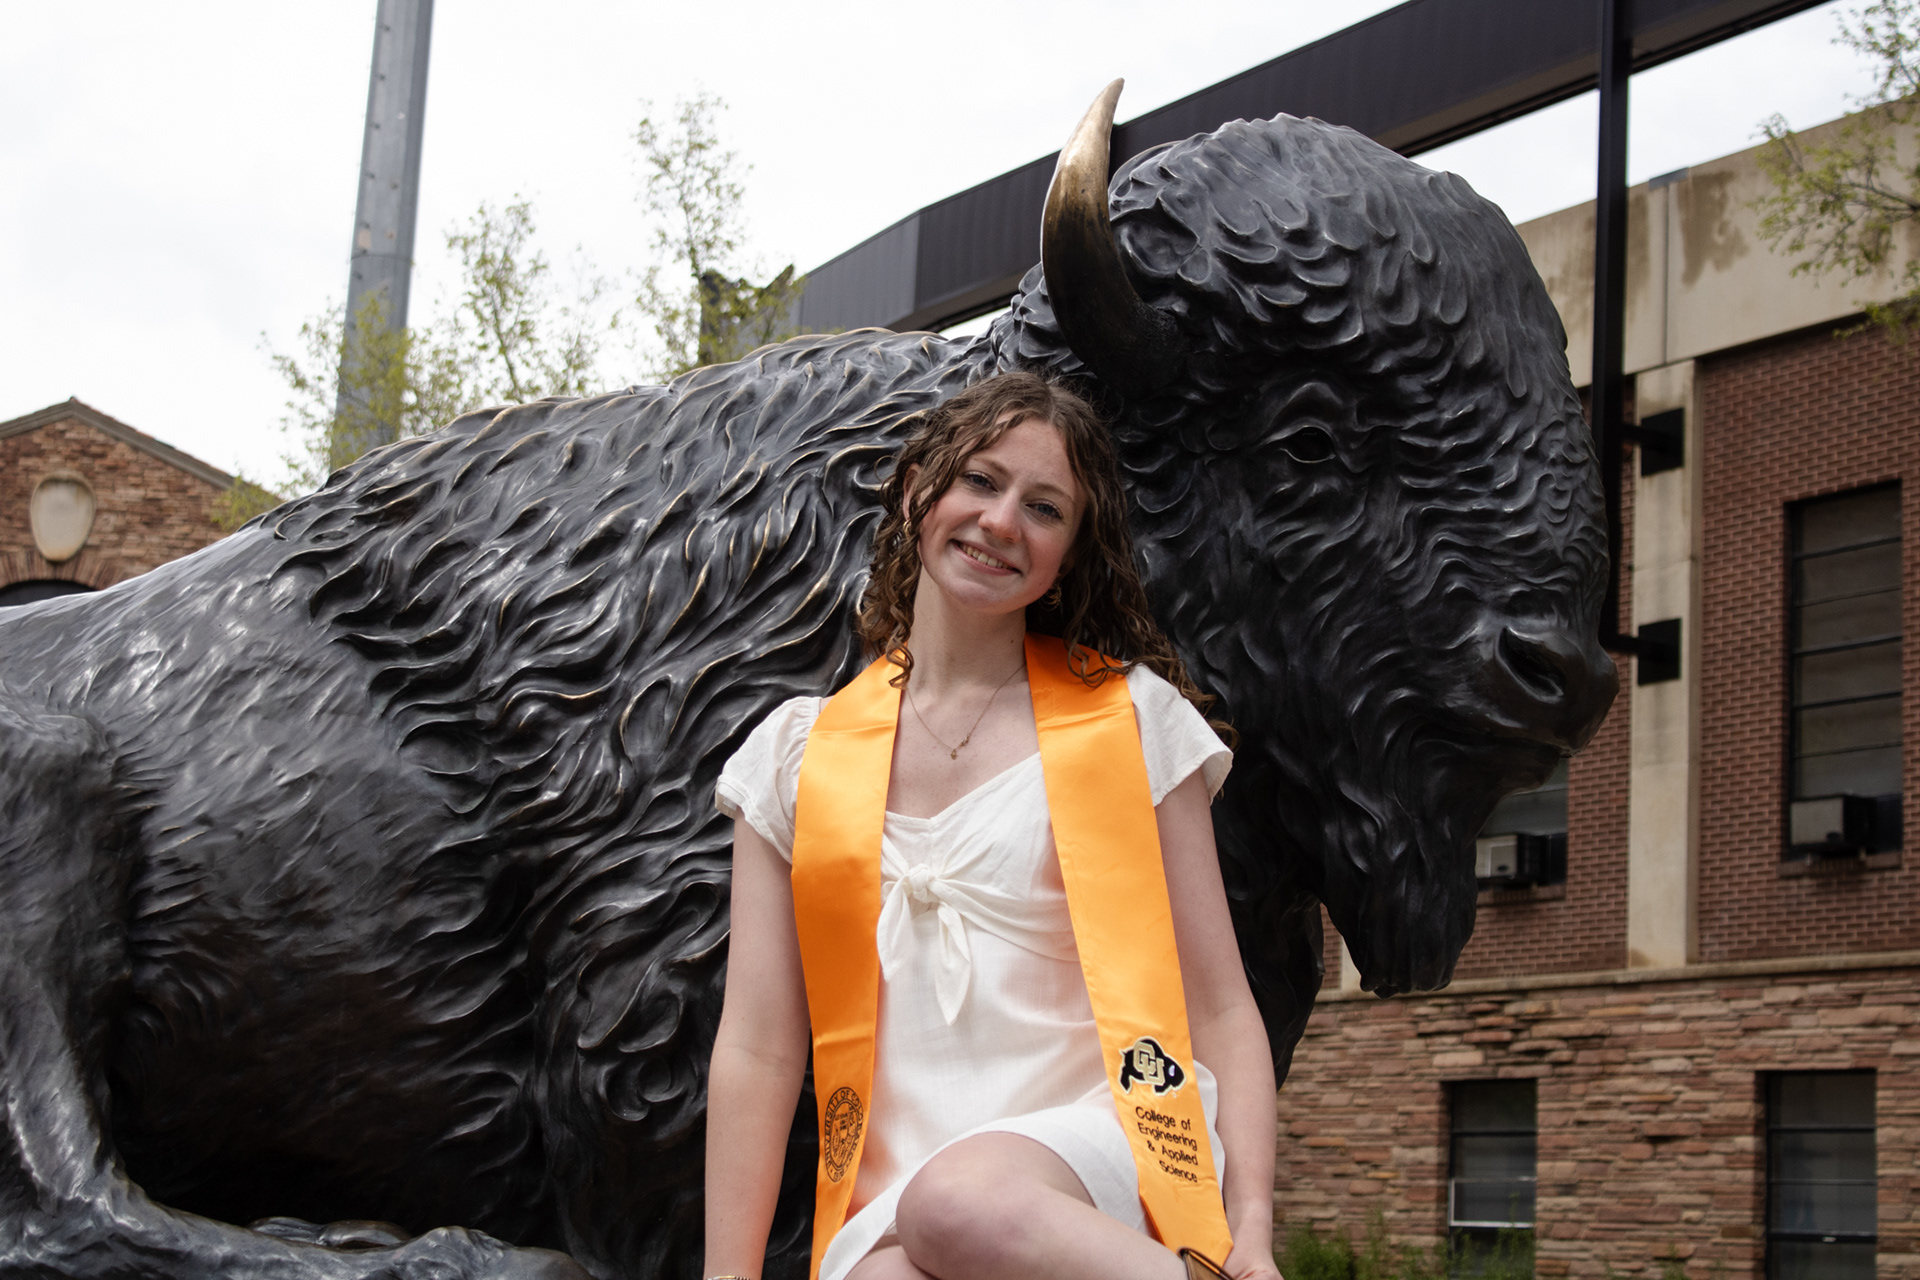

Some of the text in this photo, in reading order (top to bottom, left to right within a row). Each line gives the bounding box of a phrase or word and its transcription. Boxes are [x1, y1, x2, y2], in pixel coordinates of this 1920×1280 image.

[1133, 1041, 1166, 1086] CU
[840, 1090, 850, 1100] OF
[1135, 1106, 1191, 1131] College of
[1137, 1122, 1198, 1151] Engineering
[1147, 1140, 1198, 1166] & Applied
[1159, 1160, 1198, 1183] Science
